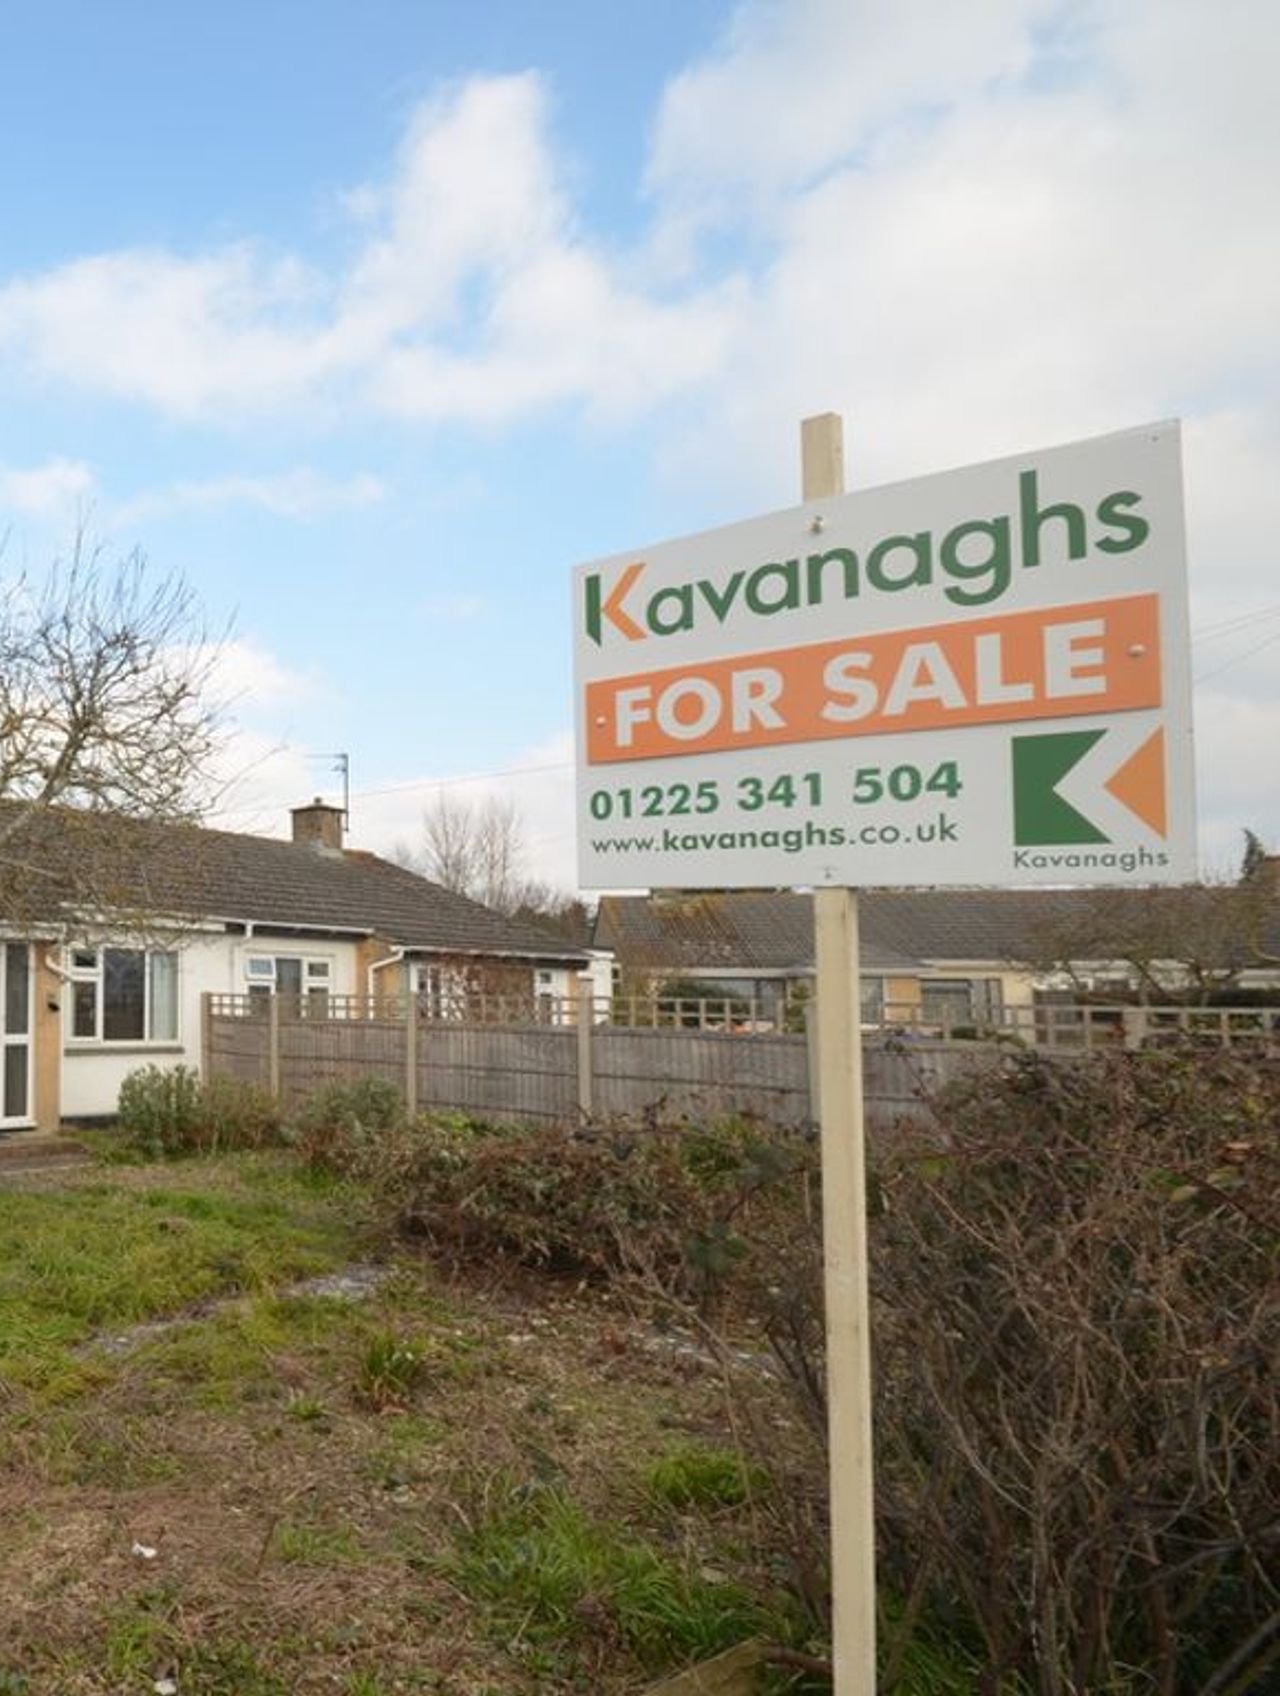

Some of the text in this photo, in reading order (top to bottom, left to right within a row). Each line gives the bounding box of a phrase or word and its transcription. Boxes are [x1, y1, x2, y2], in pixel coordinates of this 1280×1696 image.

[585, 469, 1150, 647] Kavanaghs
[614, 619, 1107, 747] FOR SALE
[589, 761, 962, 821] 01225 341 504
[592, 813, 958, 855] www.kavanaghs.co.uk
[1013, 845, 1169, 873] Kavanaghs
